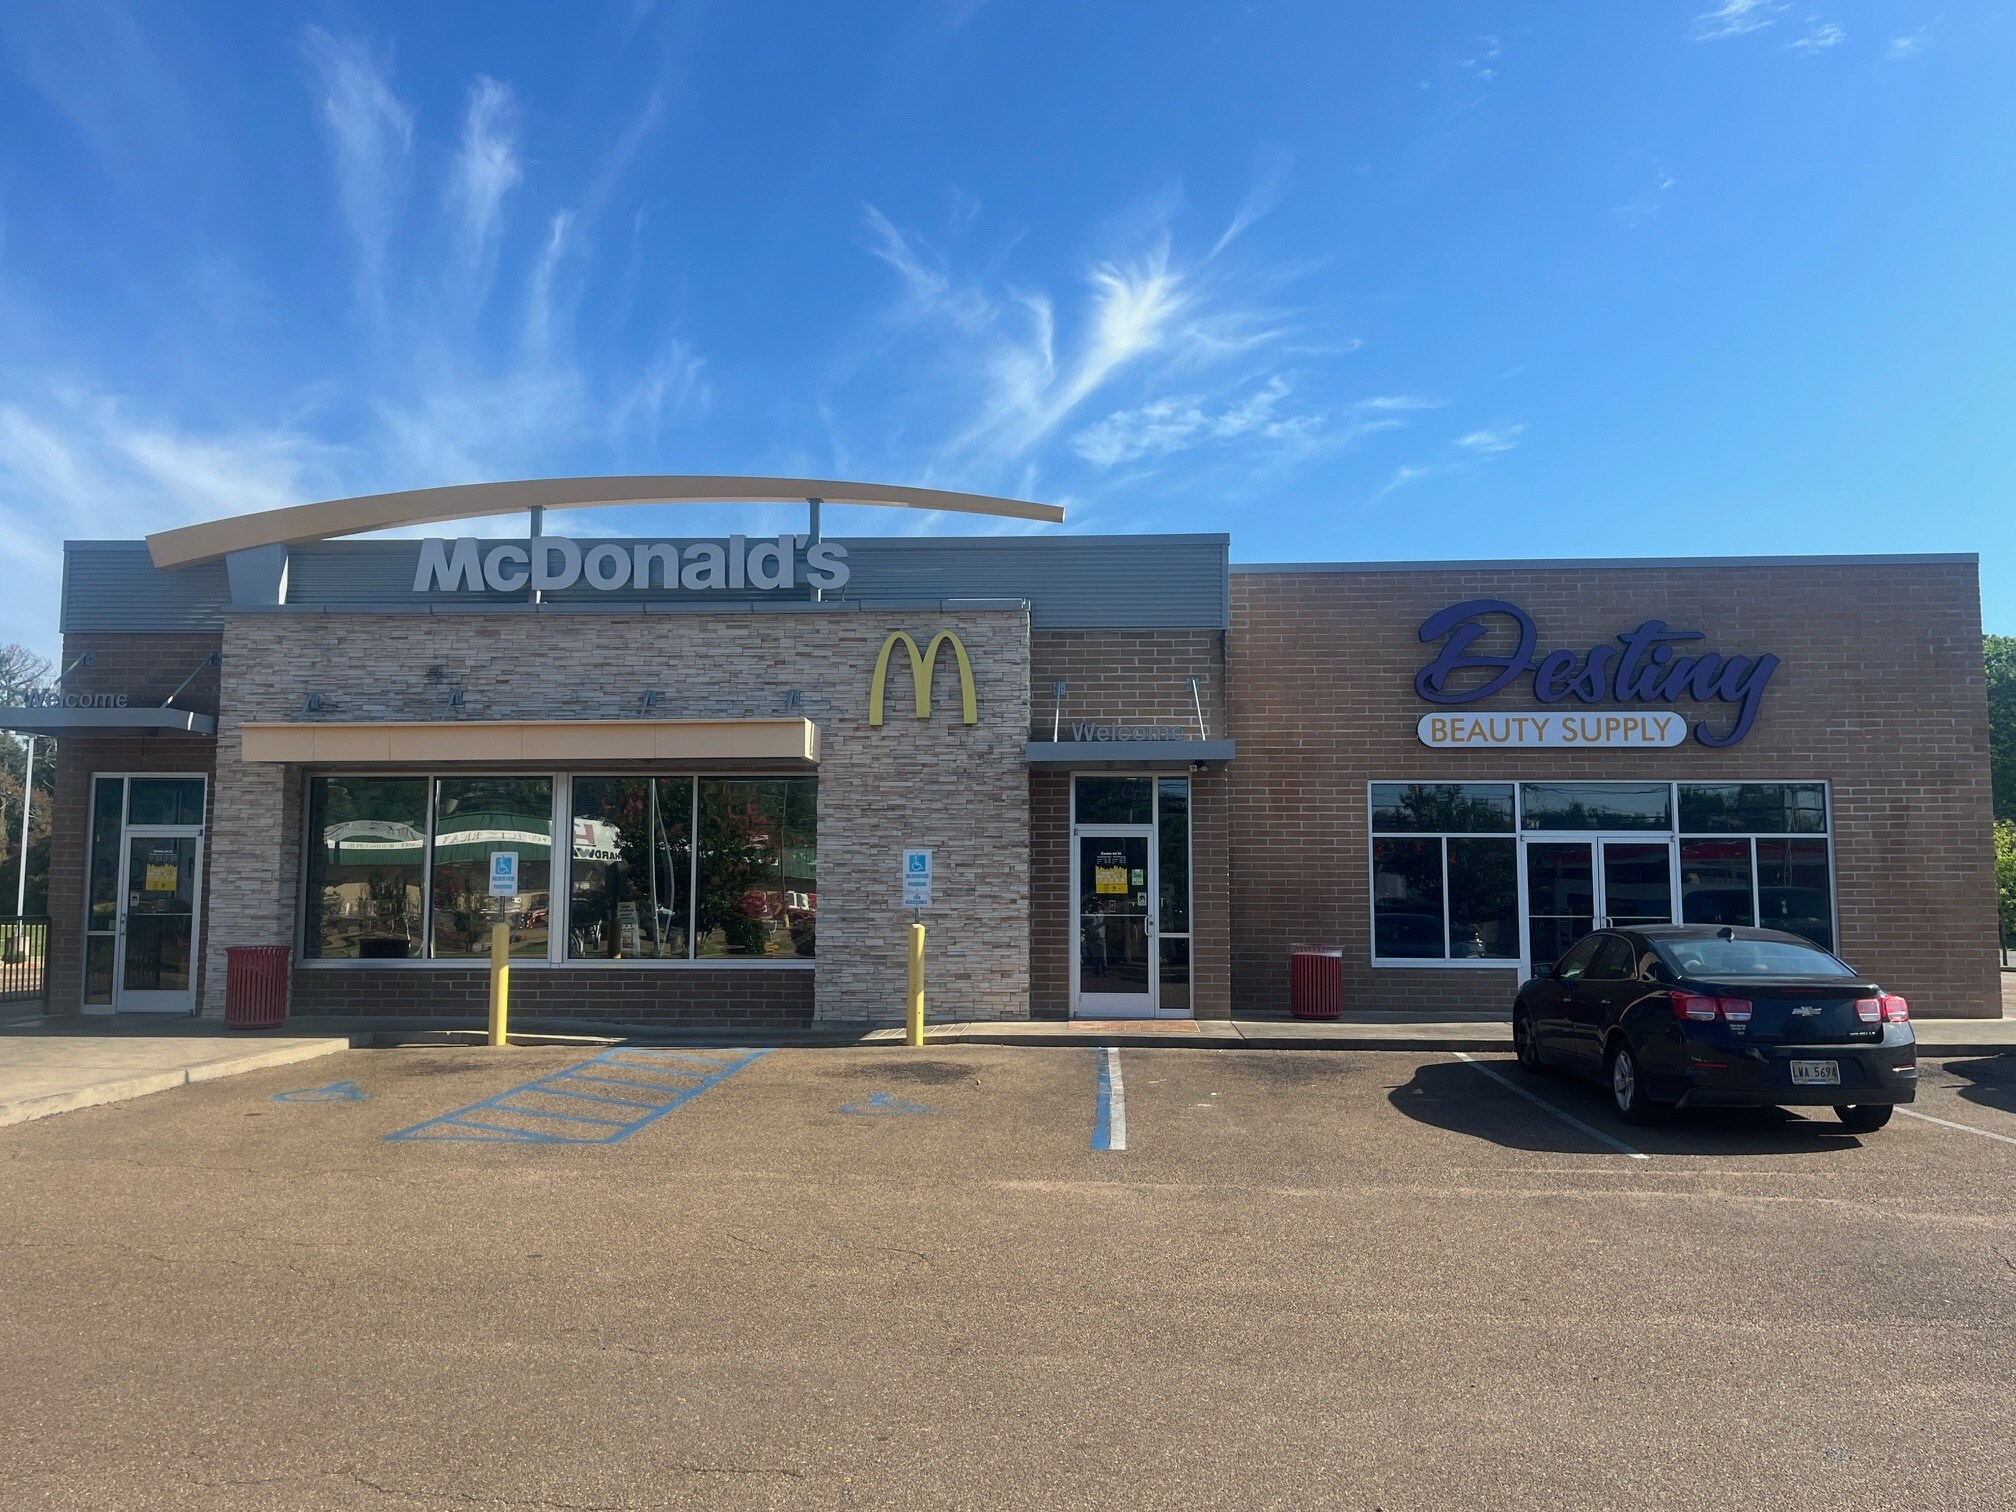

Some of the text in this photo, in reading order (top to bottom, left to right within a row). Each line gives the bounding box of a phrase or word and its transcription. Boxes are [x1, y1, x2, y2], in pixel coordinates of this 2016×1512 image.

[413, 534, 850, 591] McDonald's
[1414, 599, 1781, 748] Destiny
[26, 688, 129, 708] Welcome
[1071, 721, 1184, 741] Welcome
[1431, 716, 1673, 743] BEAUTY SUPPLY
[1814, 1066, 1837, 1078] 5694
